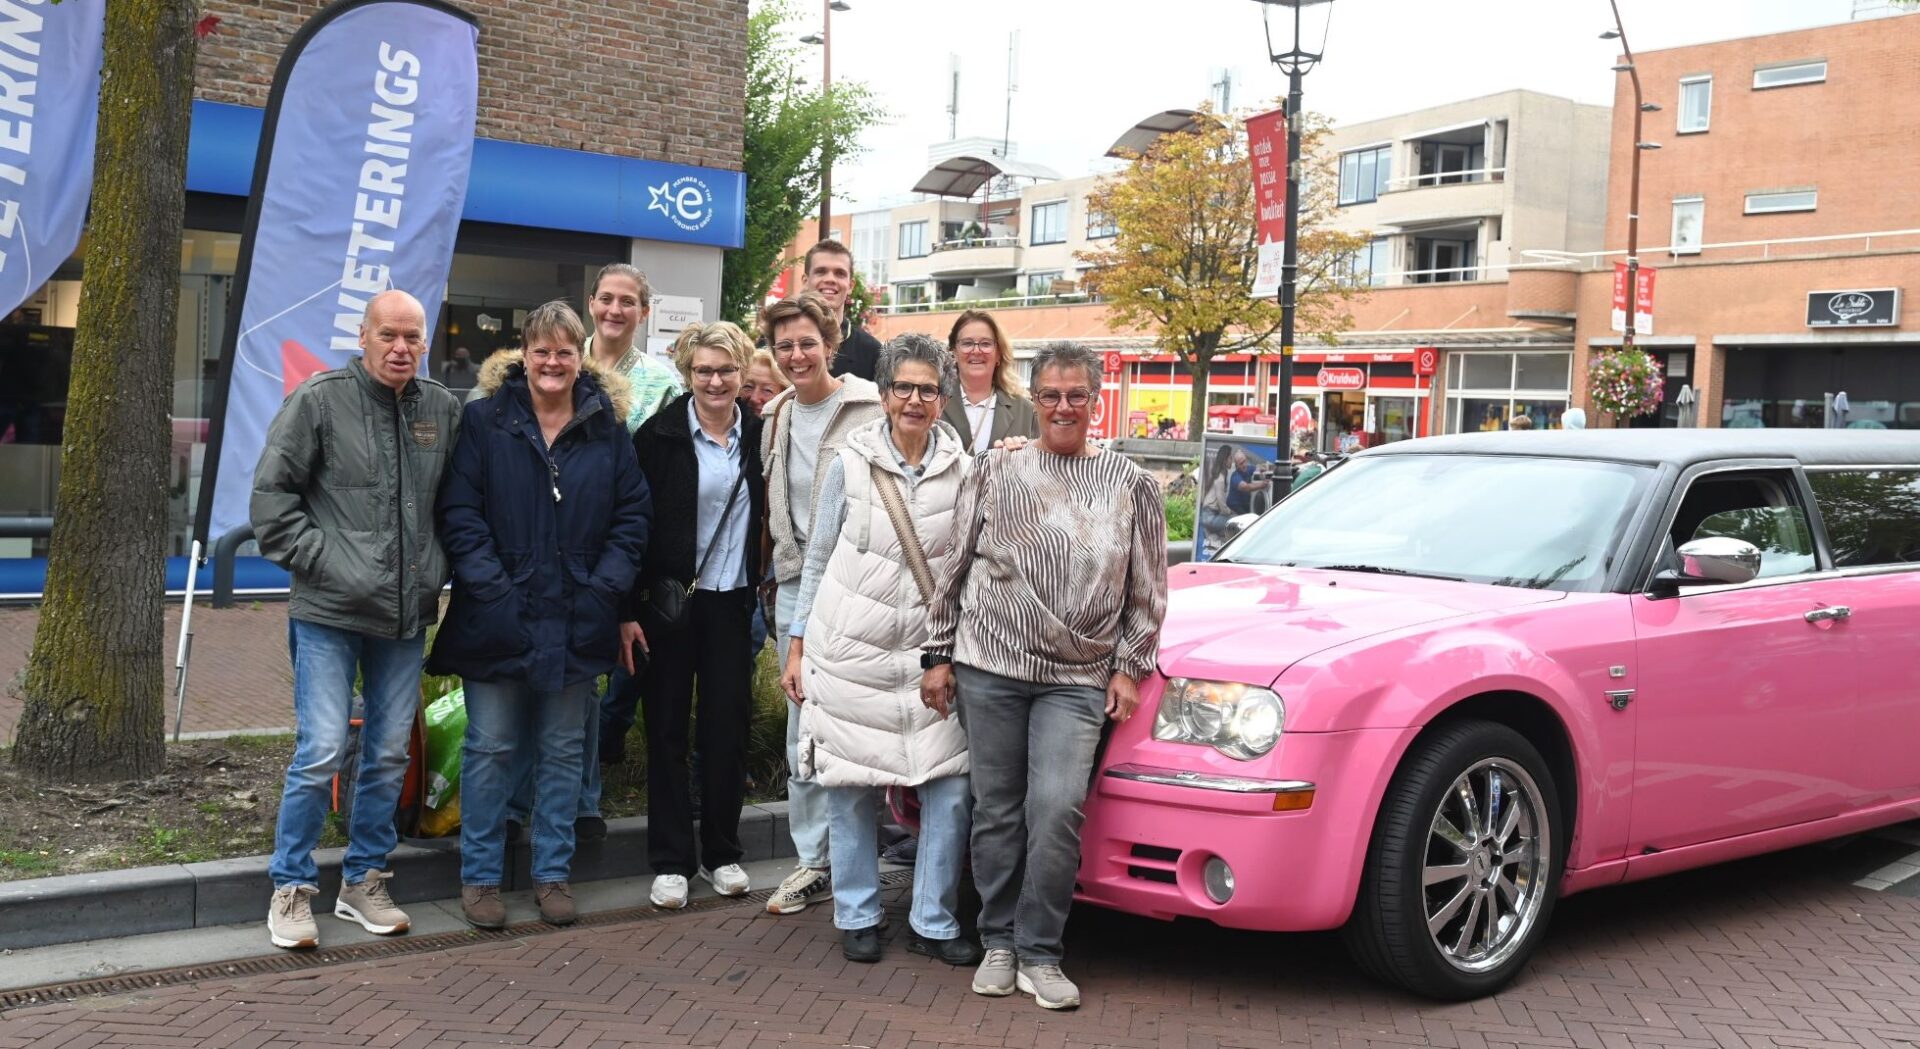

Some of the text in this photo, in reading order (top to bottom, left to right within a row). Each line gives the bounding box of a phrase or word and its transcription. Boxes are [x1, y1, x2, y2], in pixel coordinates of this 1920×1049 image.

[672, 176, 713, 202] MEMBER OF THE
[1259, 166, 1276, 190] passie
[330, 41, 421, 351] WETERINGS
[1261, 199, 1285, 221] kwaliteit
[671, 214, 700, 231] EURONICS
[1328, 372, 1360, 385] Kruidvat
